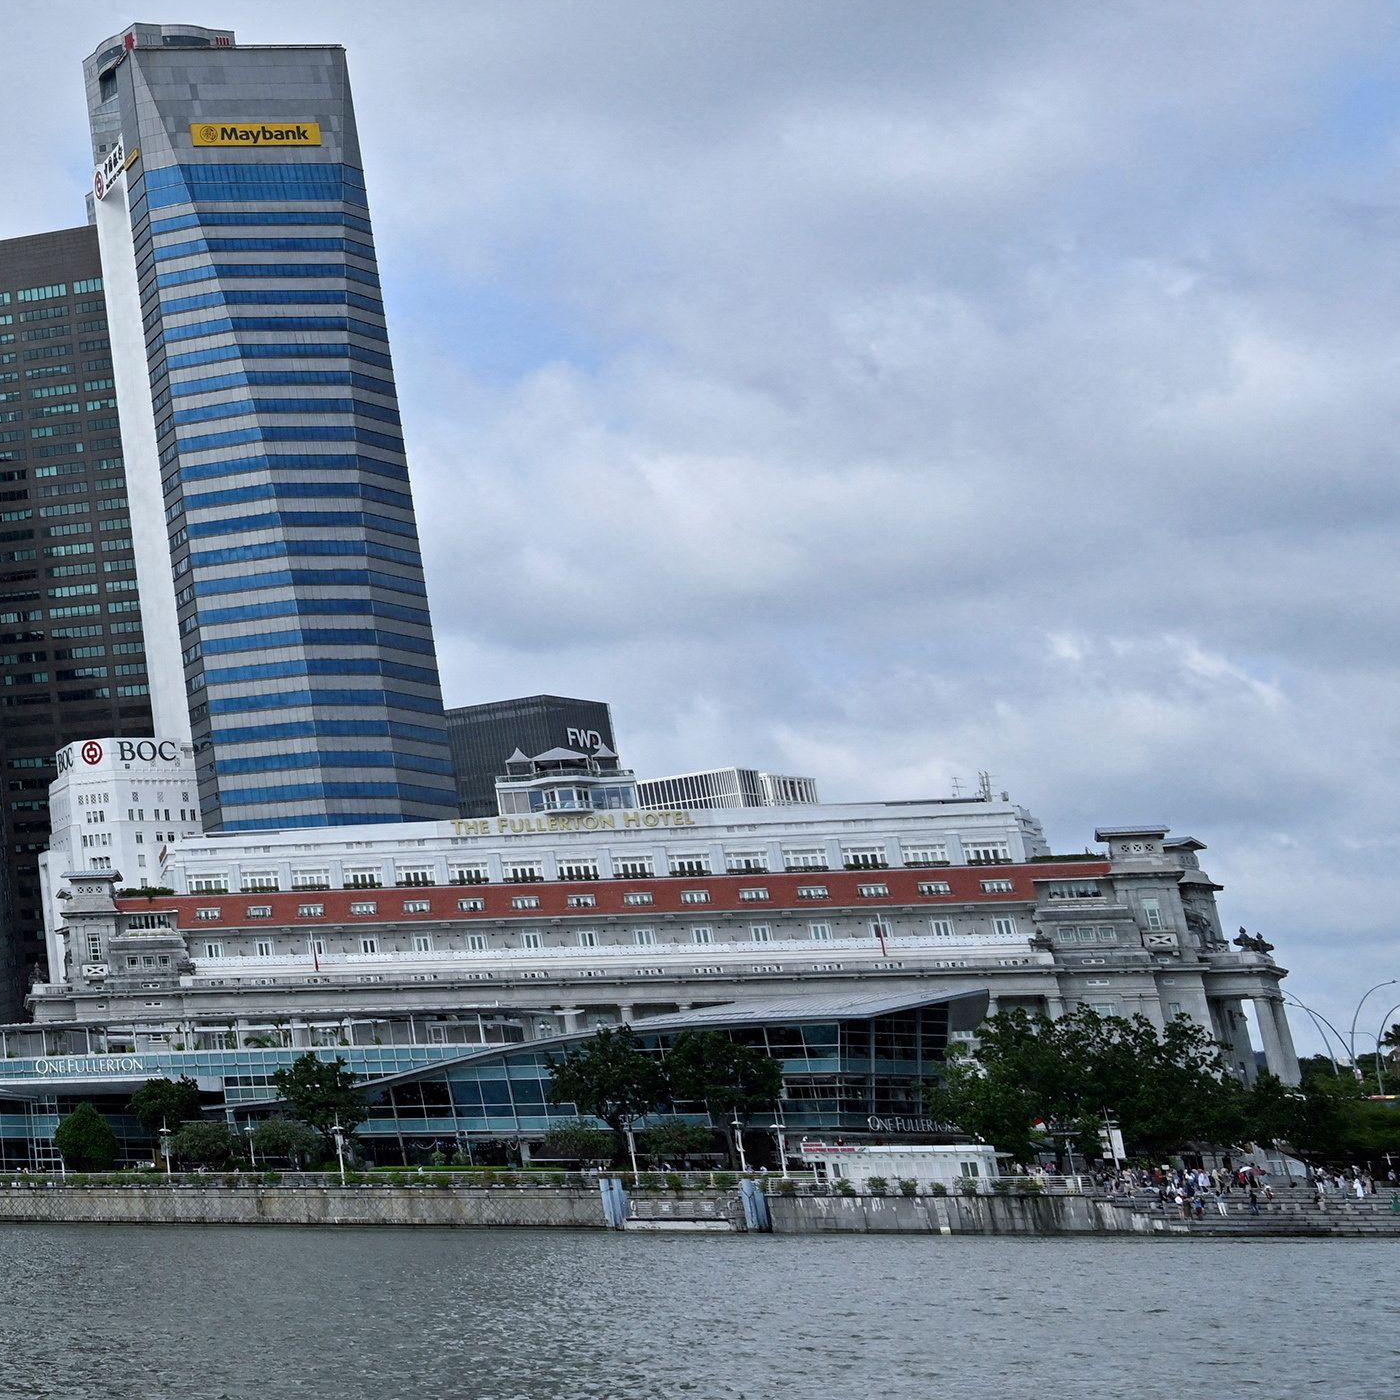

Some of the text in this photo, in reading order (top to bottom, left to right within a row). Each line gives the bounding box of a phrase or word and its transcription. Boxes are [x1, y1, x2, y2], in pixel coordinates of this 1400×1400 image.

[221, 126, 308, 143] Maybank
[566, 727, 602, 750] FWD
[57, 747, 74, 774] BOC
[117, 741, 177, 761] BOC
[451, 811, 695, 835] THE FULLERTON HOTEL
[67, 1058, 144, 1073] FULLERTON
